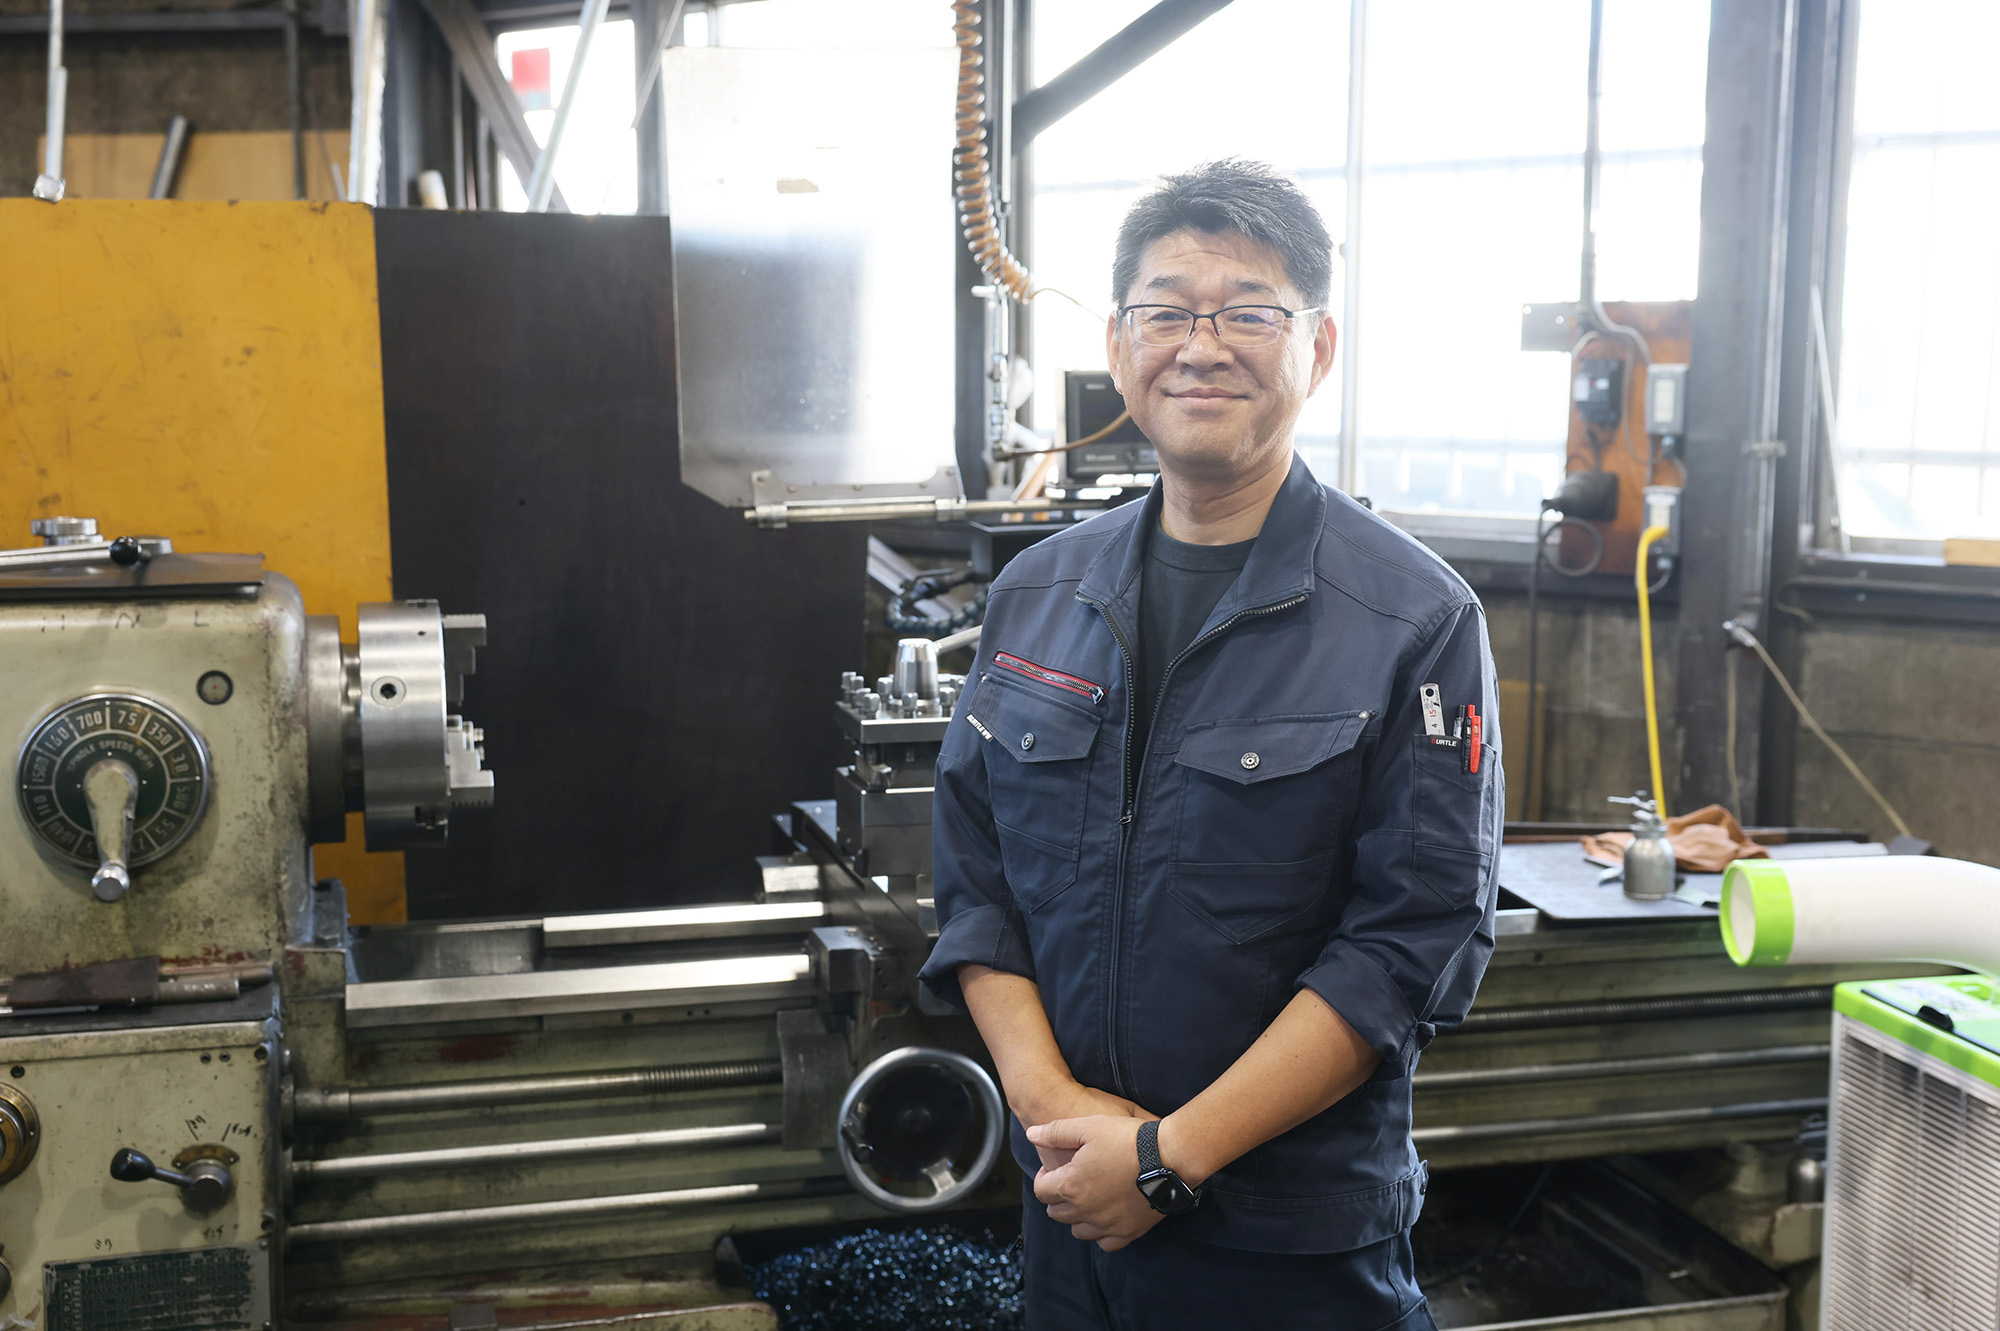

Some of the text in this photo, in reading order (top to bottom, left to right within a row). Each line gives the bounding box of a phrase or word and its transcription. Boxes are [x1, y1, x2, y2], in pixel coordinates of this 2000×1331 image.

[194, 610, 210, 628] L
[76, 710, 103, 730] 700
[118, 709, 138, 727] 75
[44, 726, 70, 752] 160
[147, 721, 174, 747] 350
[99, 740, 135, 753] SPEEDS
[171, 753, 190, 773] 38
[33, 795, 52, 816] 110
[173, 786, 189, 810] 500
[155, 818, 175, 838] 55
